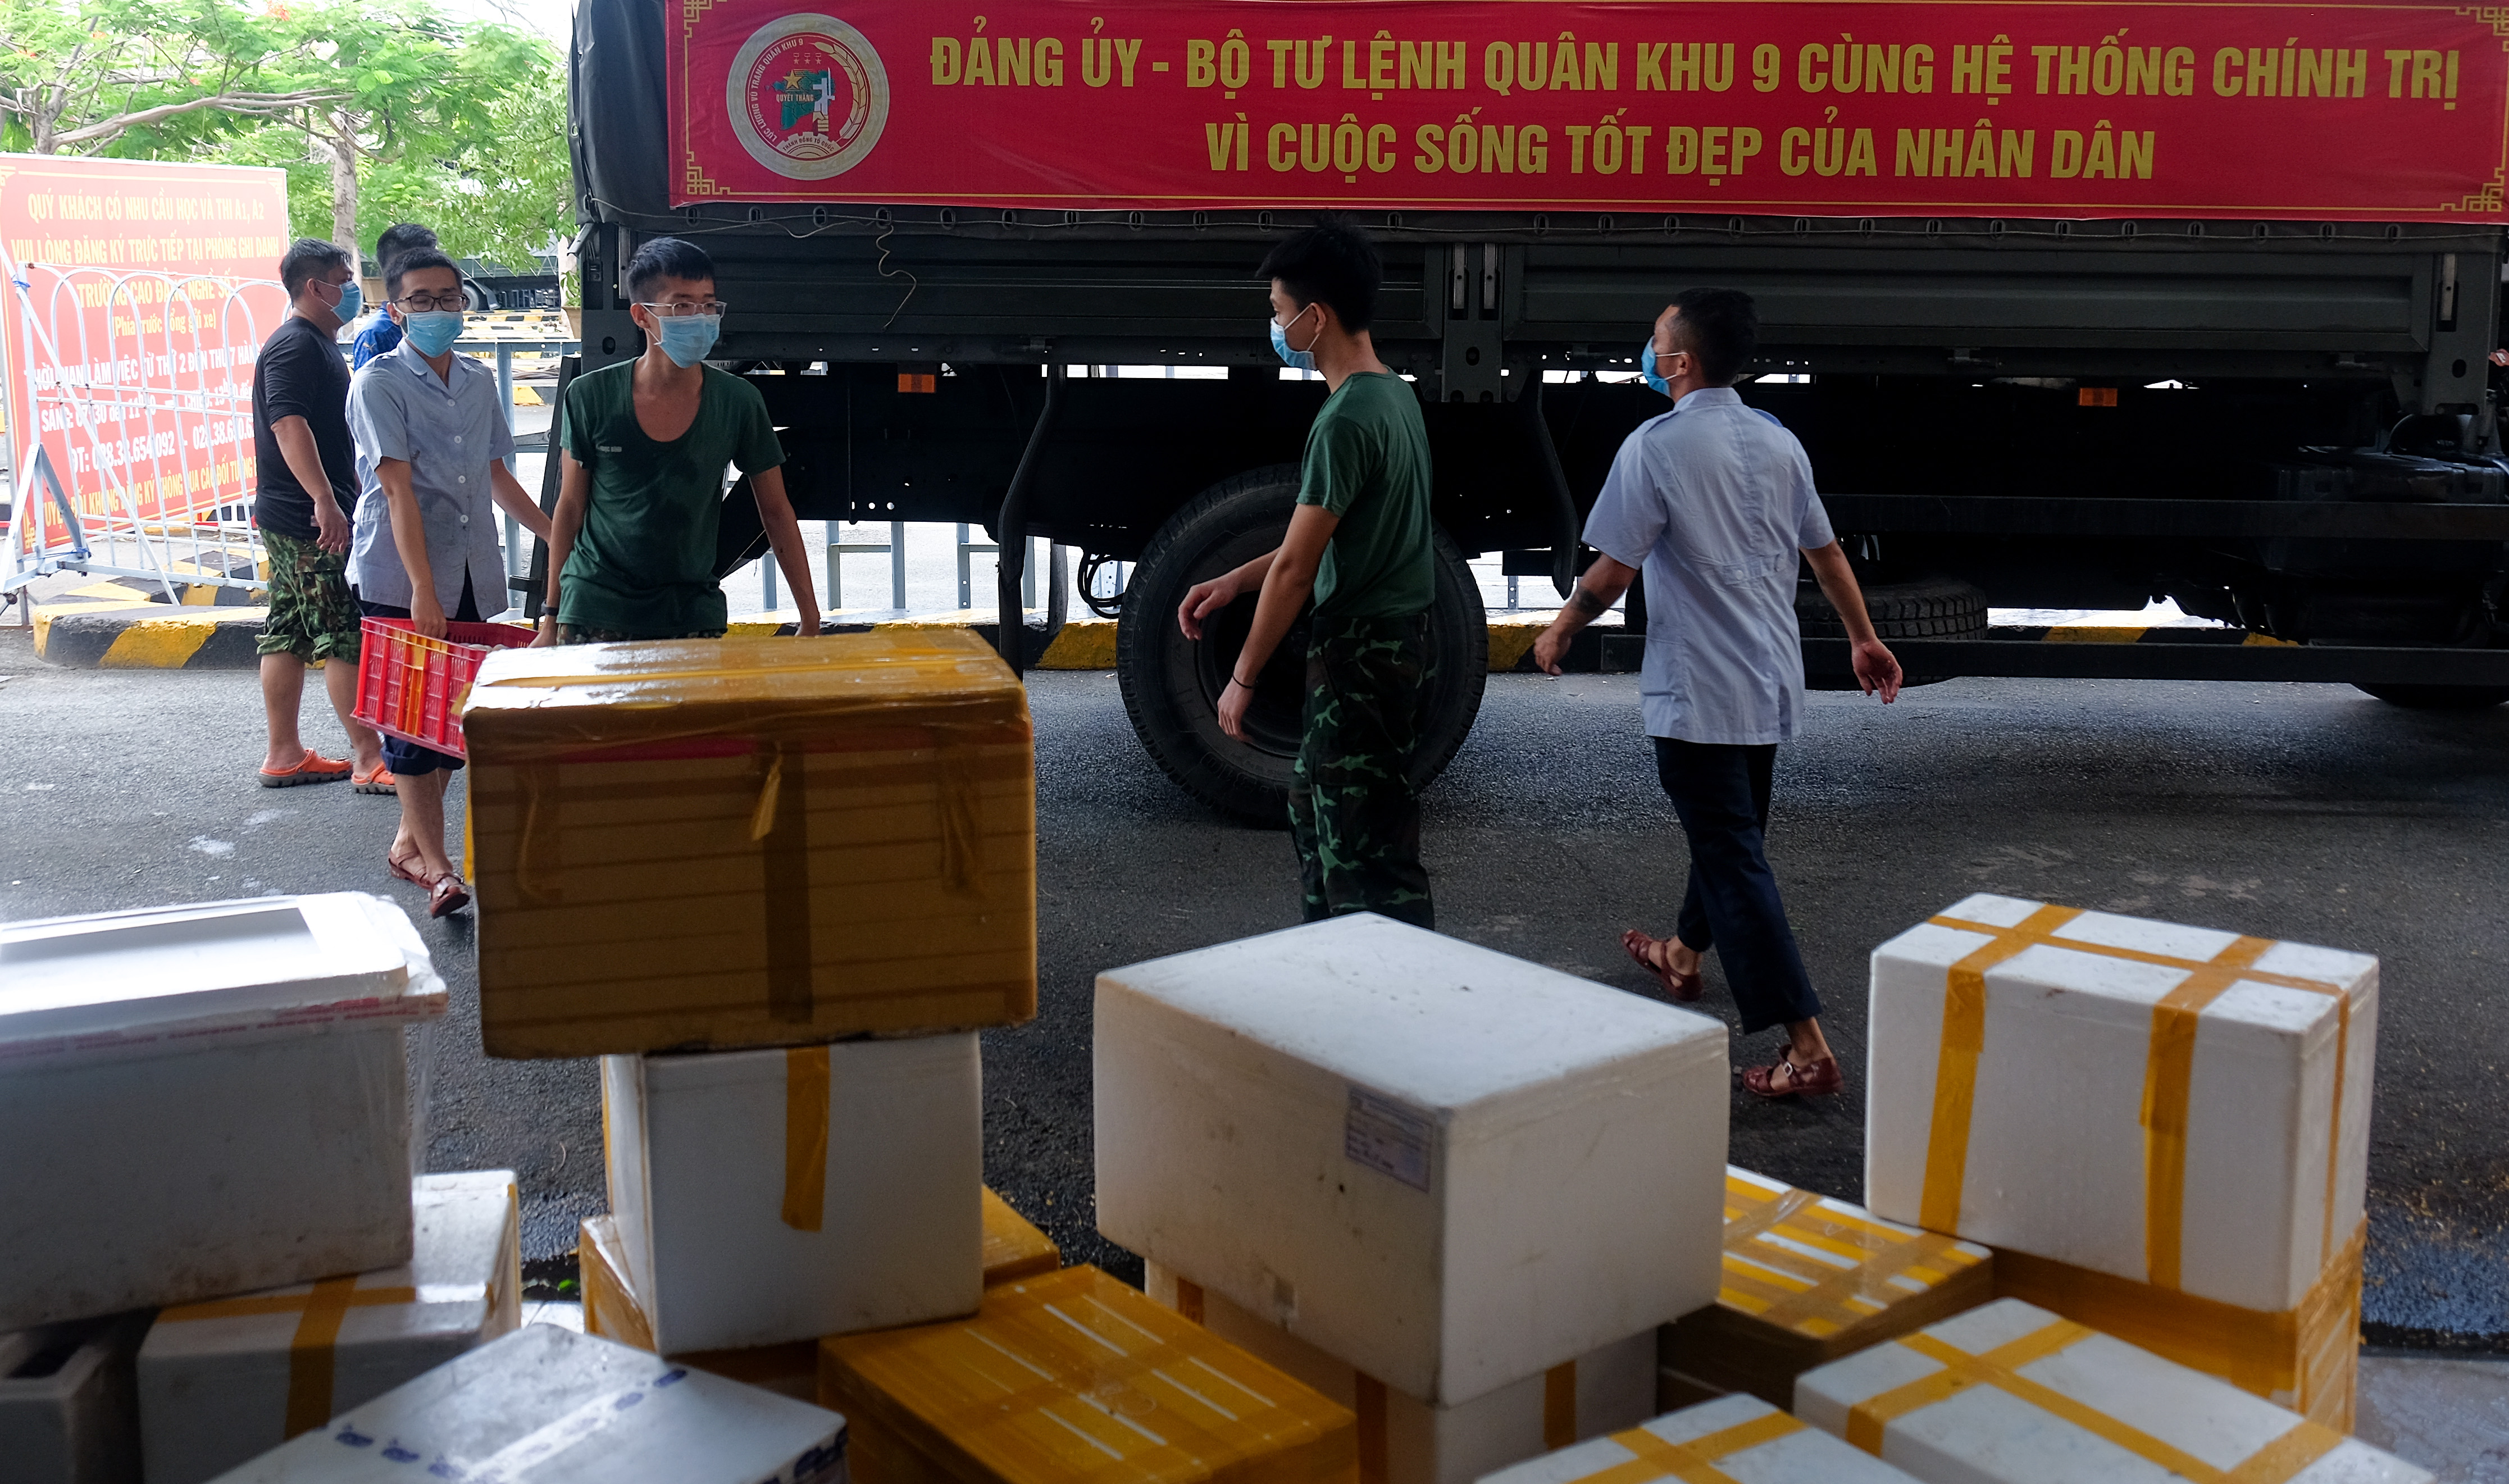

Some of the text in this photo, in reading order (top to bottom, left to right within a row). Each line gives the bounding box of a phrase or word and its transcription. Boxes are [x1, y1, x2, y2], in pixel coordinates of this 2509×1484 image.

[751, 63, 766, 89] TRANG
[781, 39, 797, 51] KHU
[931, 16, 2458, 109] ĐẢNG ỦY - BỘ TƯ LỆNH QUÂN KHU 9 CÙNG HỆ THỐNG CHÍNH TRỊ
[1206, 107, 2154, 185] VÌ CUỘC SỐNG TỐT ĐẸP CỦA NHÂN DÂN
[28, 187, 265, 225] QUÝ KHÁCH CÓ NHU CẦU HỌC VÀ THI A1, A2
[11, 229, 279, 267] VUI LÒNG ĐĂNG KÝ TRỰC TIẾP TẠI PHÒNG GHI DANH
[76, 276, 128, 308] TRƯỜNG
[130, 280, 153, 305] CAO
[141, 313, 162, 334] rước
[169, 308, 186, 334] ổng
[203, 308, 216, 329] xe)
[179, 353, 186, 373] 2
[144, 474, 154, 504] KÝ
[161, 470, 183, 499] HÔNG
[189, 470, 199, 493] UA
